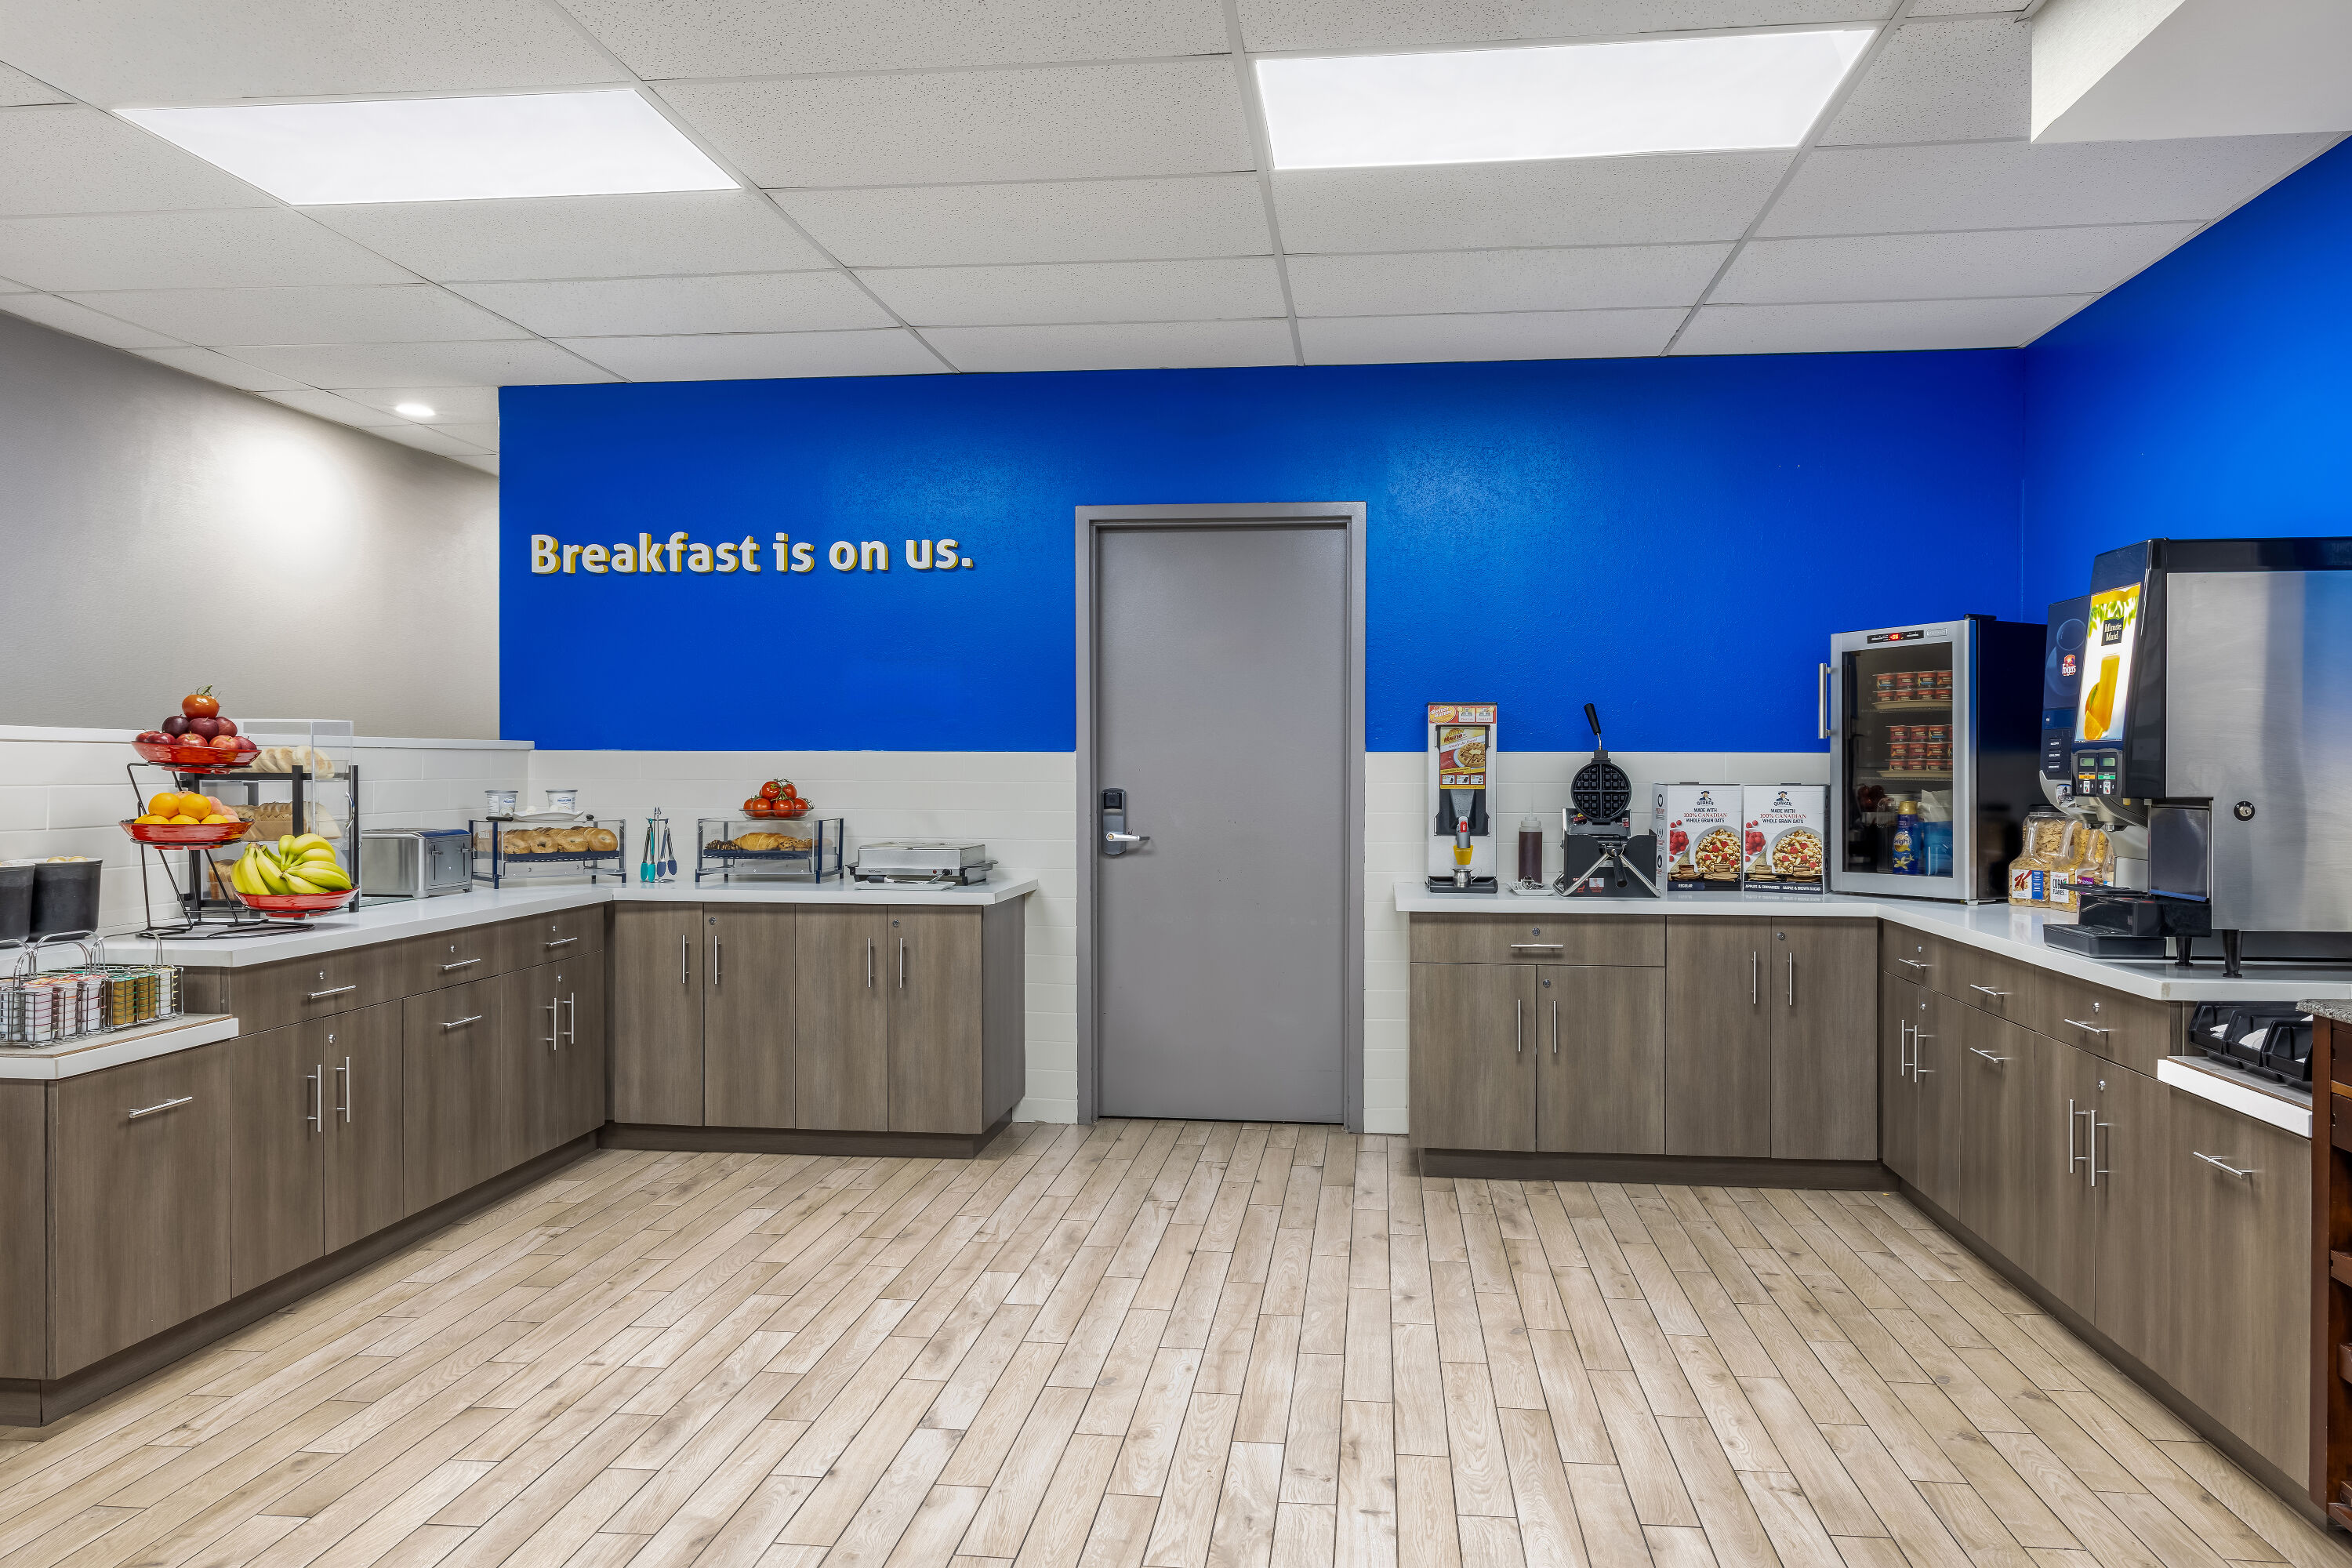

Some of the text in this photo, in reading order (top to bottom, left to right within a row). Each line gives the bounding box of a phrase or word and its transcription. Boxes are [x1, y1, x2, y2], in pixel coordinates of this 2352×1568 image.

[531, 532, 973, 574] Breakfast is on us.
[2104, 623, 2122, 632] Minute
[2105, 631, 2118, 641] Maid
[2062, 663, 2076, 676] Folgers
